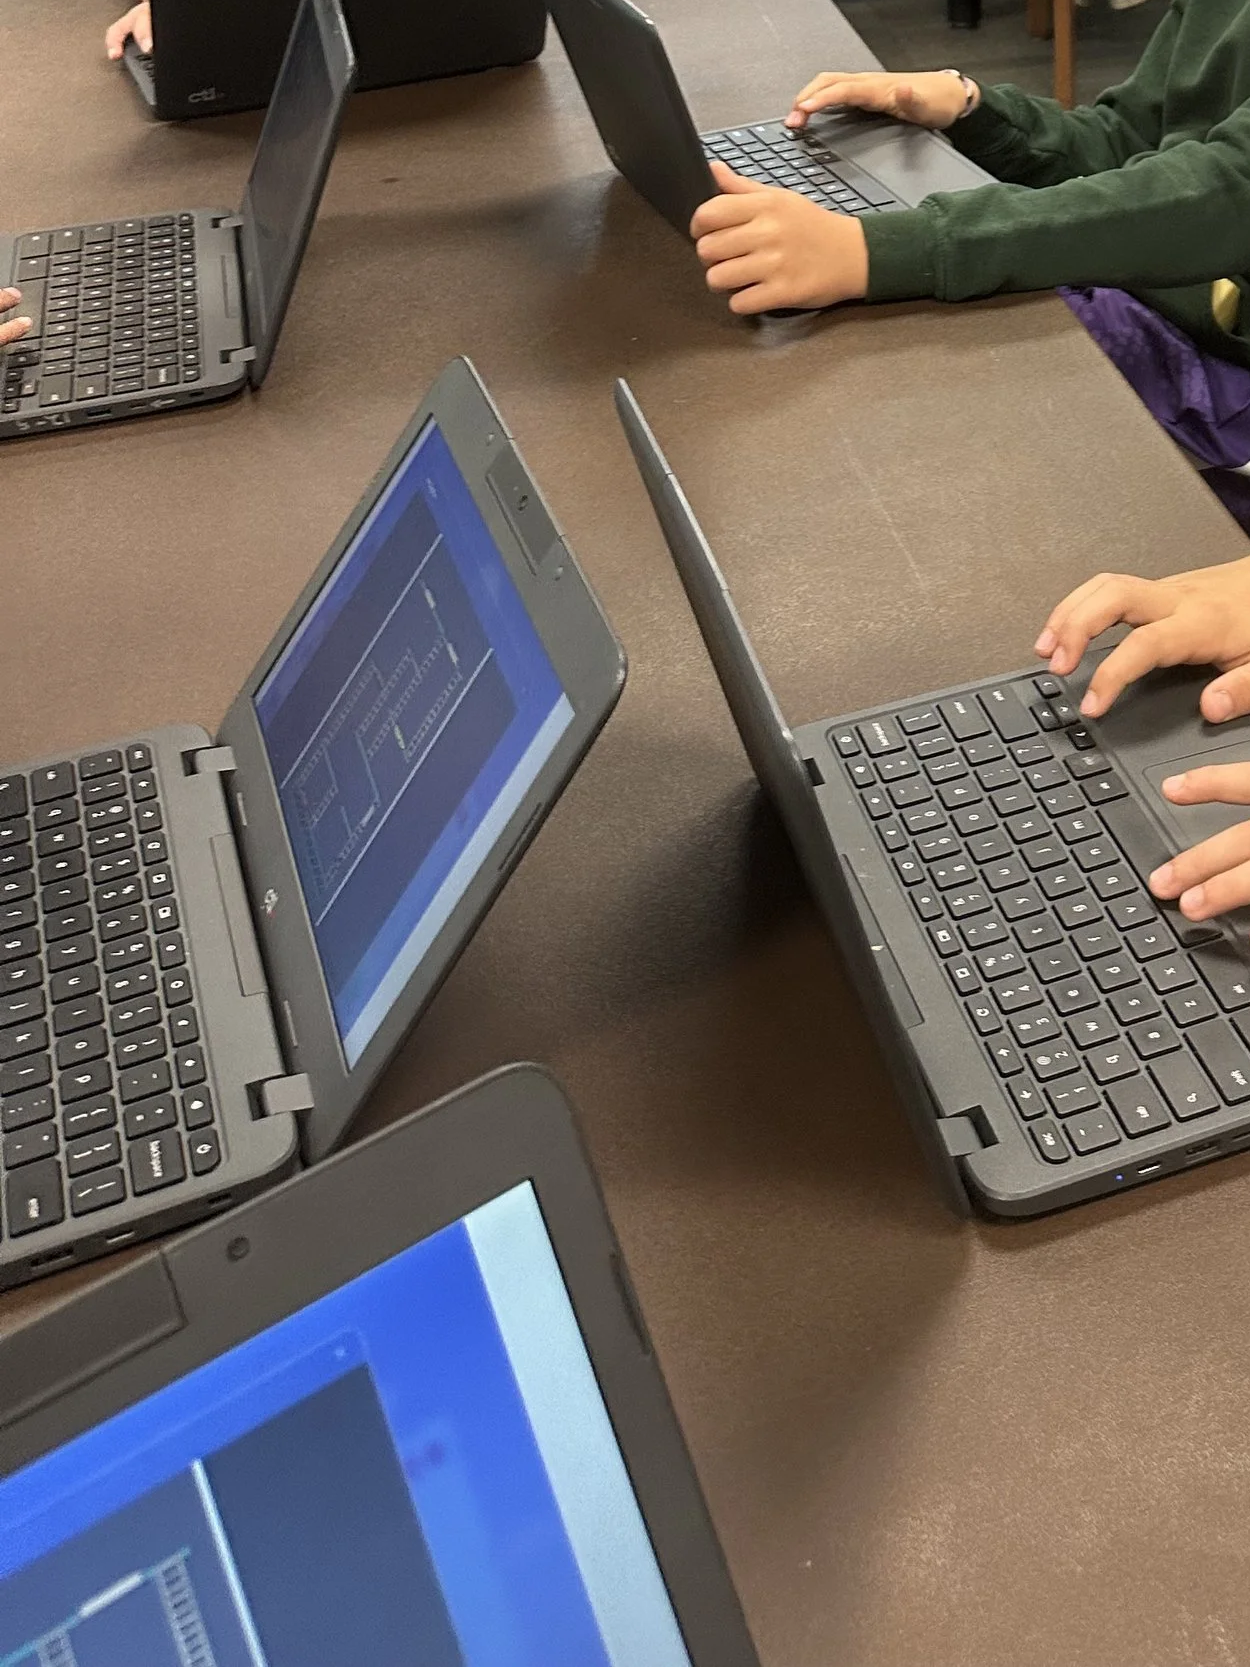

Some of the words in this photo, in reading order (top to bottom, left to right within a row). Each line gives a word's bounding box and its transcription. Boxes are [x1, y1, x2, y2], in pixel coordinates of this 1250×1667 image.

[1073, 821, 1084, 829] m
[11, 970, 26, 978] h
[1086, 1022, 1098, 1031] w
[1106, 1055, 1119, 1063] q
[75, 1075, 91, 1083] p
[1231, 1070, 1247, 1085] shift
